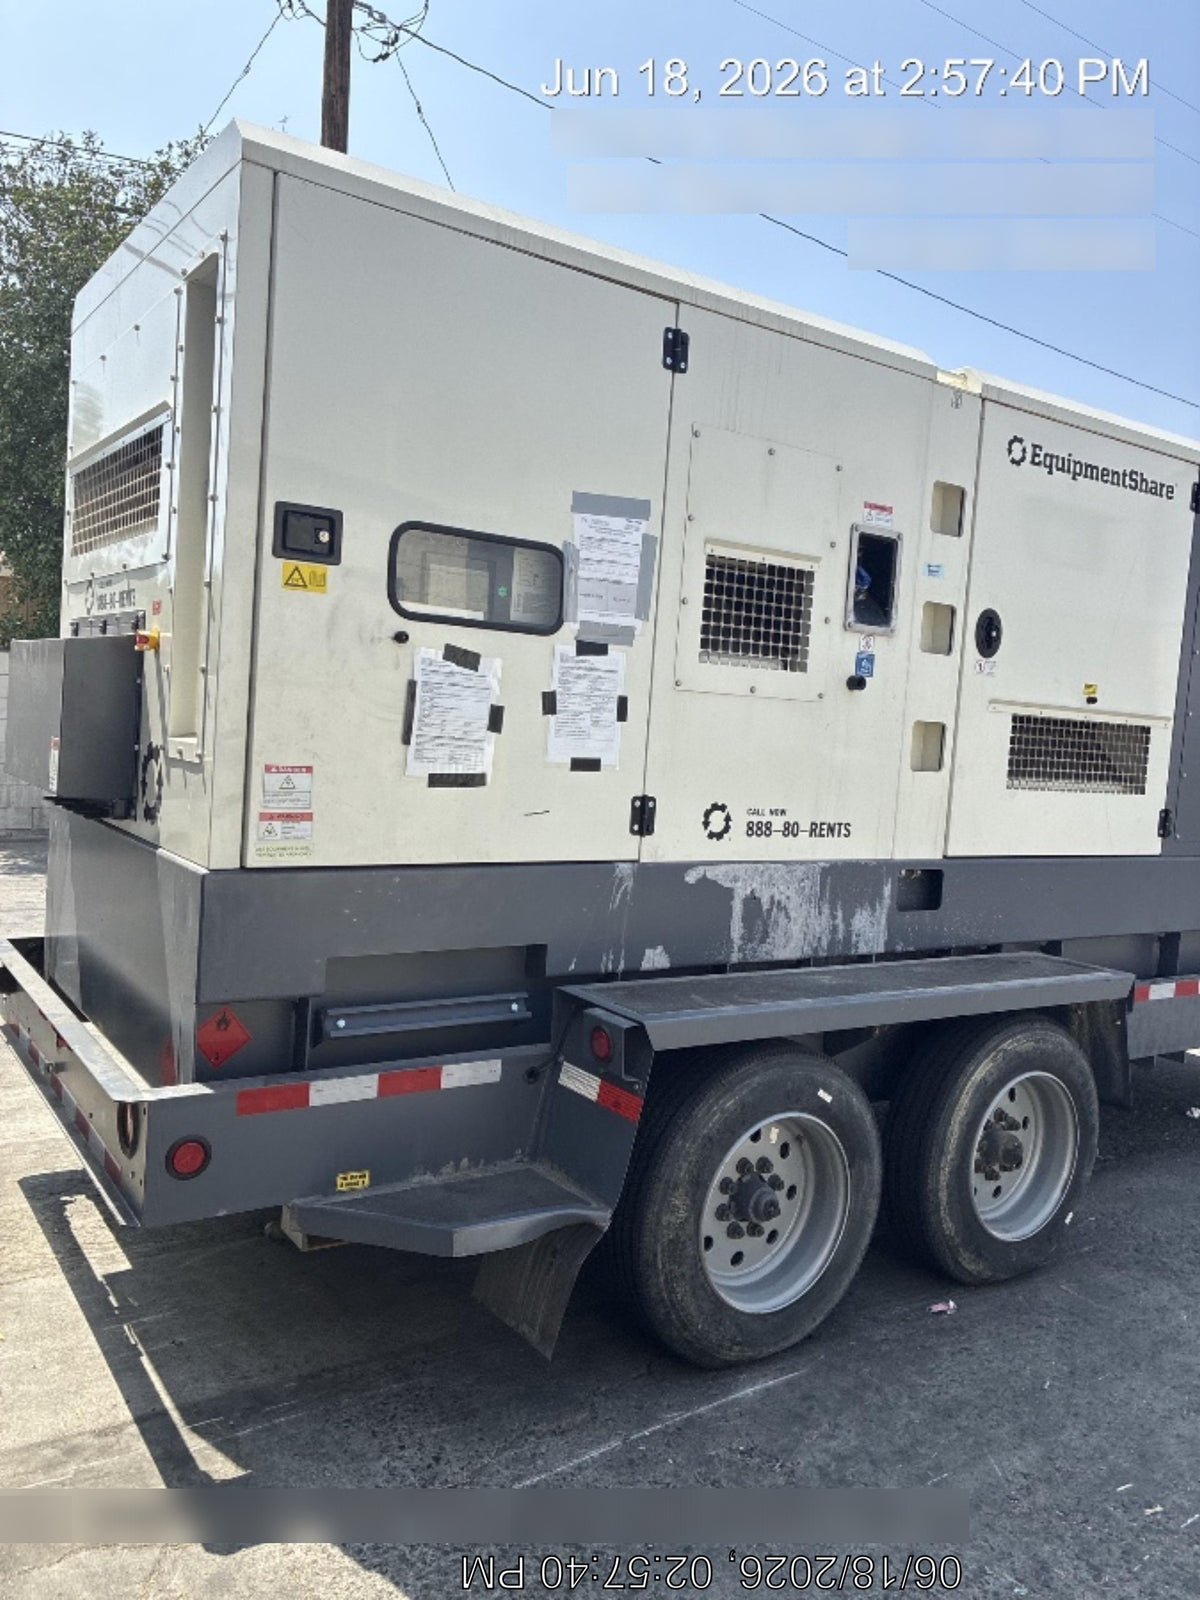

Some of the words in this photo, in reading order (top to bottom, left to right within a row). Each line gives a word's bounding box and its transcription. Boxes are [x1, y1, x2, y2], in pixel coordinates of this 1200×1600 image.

[1030, 443, 1174, 500] EquipmentShare
[746, 808, 766, 817] CALL
[746, 820, 852, 839] 888-80-RENTS
